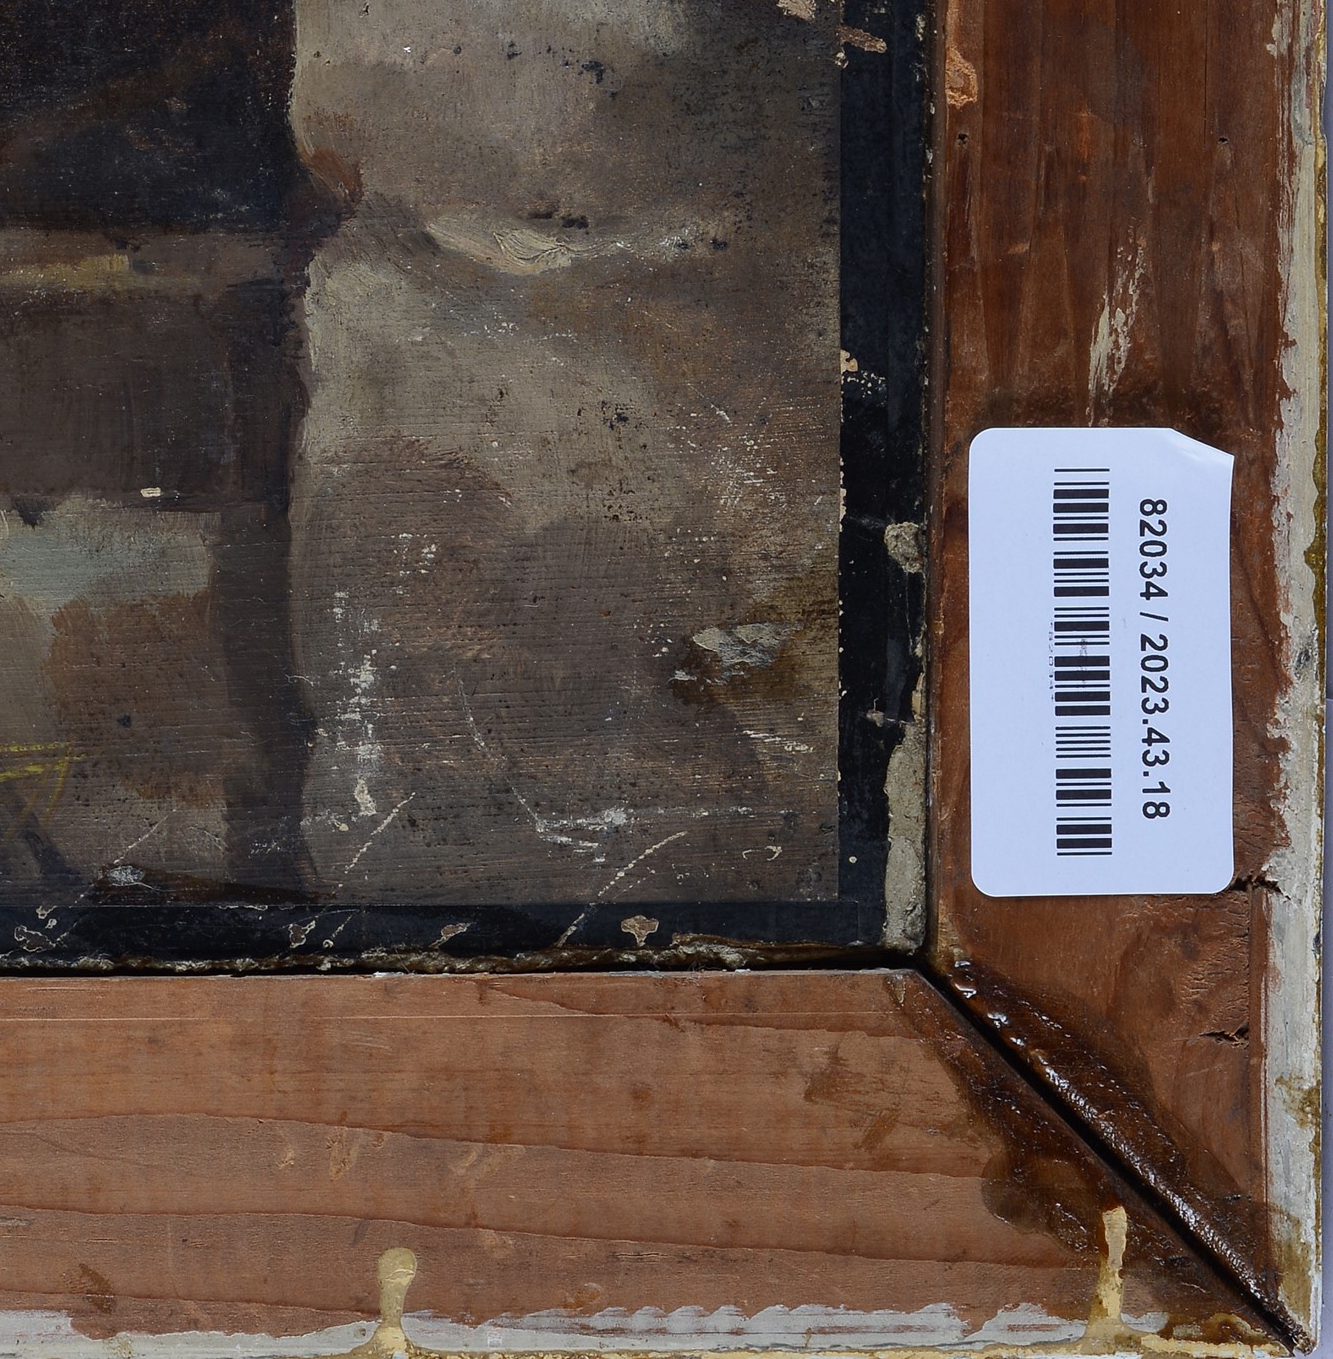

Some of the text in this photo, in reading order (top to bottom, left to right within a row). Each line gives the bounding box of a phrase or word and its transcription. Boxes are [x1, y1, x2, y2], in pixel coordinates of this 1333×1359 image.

[1139, 499, 1170, 819] 82034 / 2023.43.18
